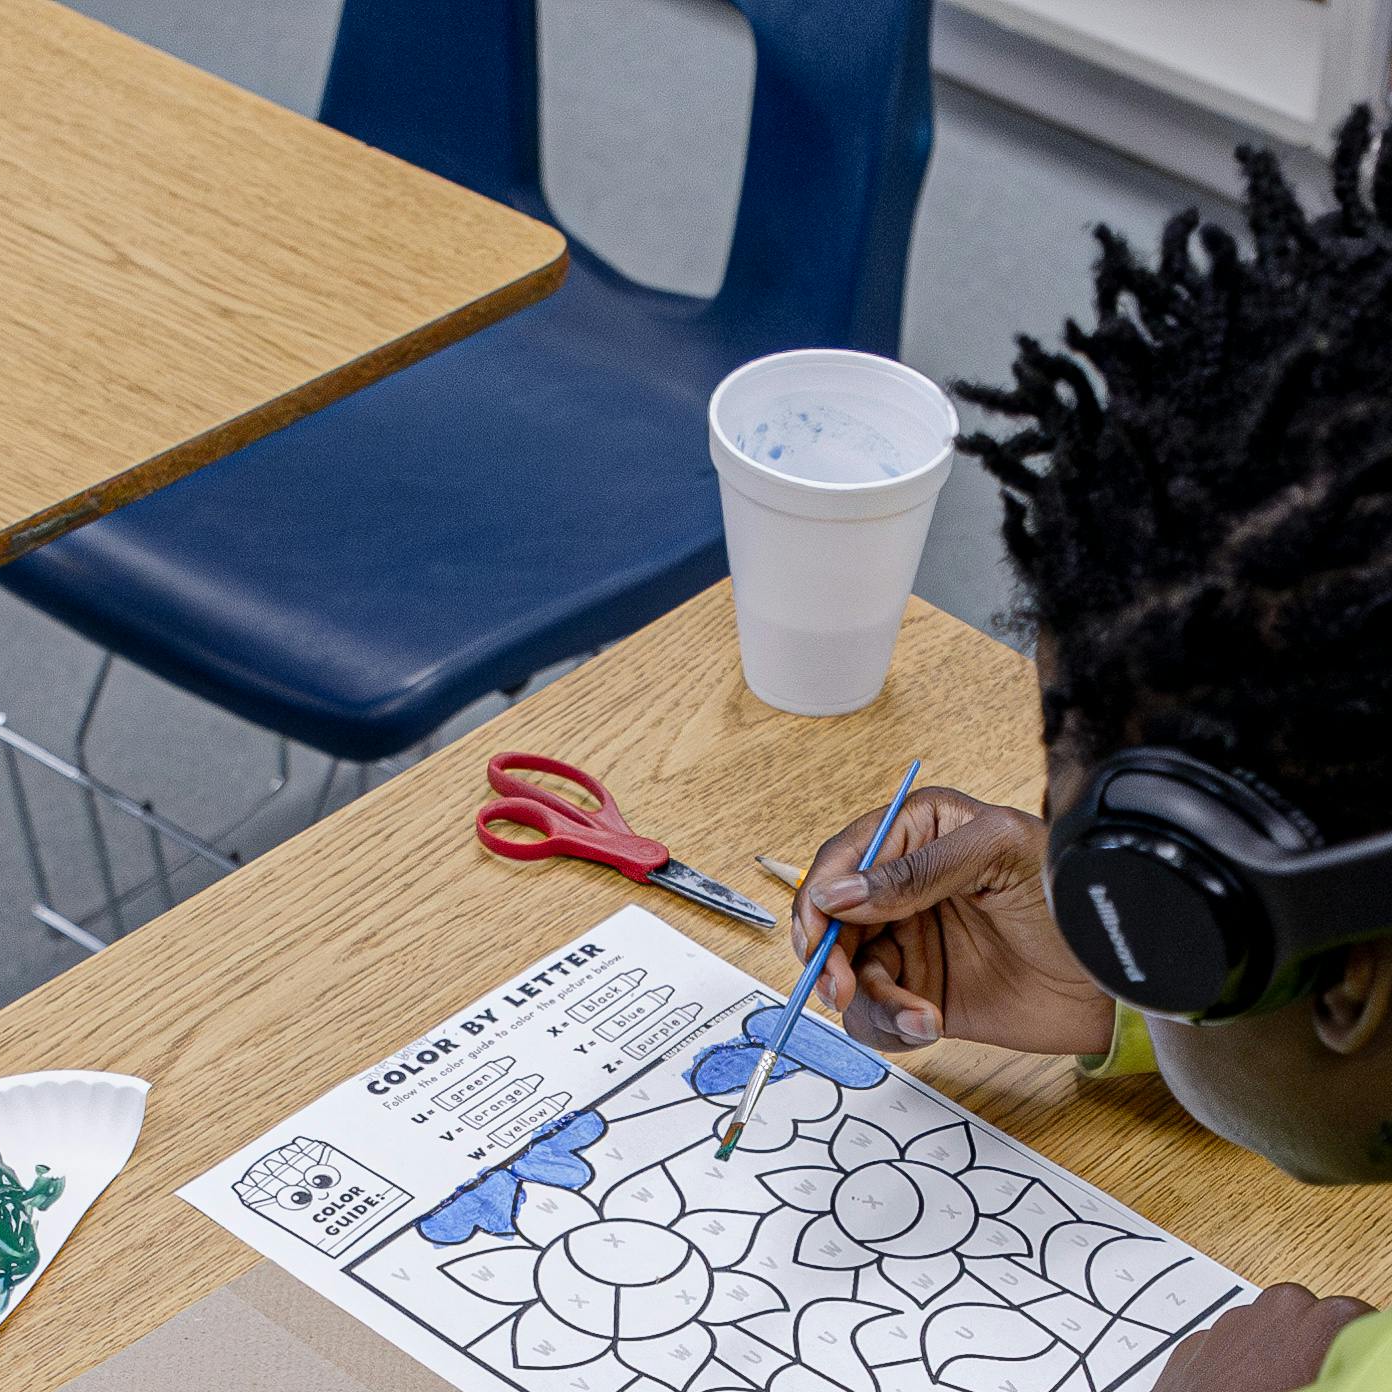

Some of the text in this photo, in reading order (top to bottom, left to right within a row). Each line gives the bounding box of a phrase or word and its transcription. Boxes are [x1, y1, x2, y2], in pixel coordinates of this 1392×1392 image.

[582, 984, 624, 1013] black
[366, 942, 608, 1096] COLOR BY LETTER
[612, 1004, 646, 1028] blue
[382, 953, 626, 1112] Follow the color guide to color the picture below.
[636, 1016, 681, 1053] purple
[449, 1072, 493, 1103] green
[631, 1089, 650, 1101] V
[473, 1088, 524, 1123] orange
[889, 1101, 908, 1113] V
[503, 1107, 549, 1140] yellow
[850, 1133, 872, 1149] W
[605, 1148, 624, 1160] V
[928, 1146, 950, 1161] W
[705, 1166, 724, 1179] V
[794, 1179, 817, 1195] W
[996, 1181, 1017, 1196] W
[631, 1187, 654, 1203] W
[862, 1195, 883, 1209] X
[311, 1185, 366, 1225] COLOR
[536, 1198, 559, 1214] W
[940, 1205, 962, 1219] X
[1027, 1203, 1045, 1215] V
[1080, 1199, 1098, 1213] V
[324, 1193, 387, 1237] GUIDE:
[702, 1220, 725, 1235] W
[603, 1233, 625, 1248] X
[986, 1231, 1008, 1246] W
[1070, 1235, 1089, 1247] U
[819, 1240, 842, 1257] W
[760, 1256, 778, 1269] V
[391, 1268, 410, 1280] V
[472, 1266, 495, 1281] W
[912, 1273, 934, 1289] W
[1000, 1272, 1018, 1285] U
[1116, 1269, 1134, 1282] V
[675, 1289, 697, 1305] X
[726, 1285, 749, 1301] W
[1166, 1293, 1186, 1306] Z
[568, 1294, 589, 1309] X
[1061, 1318, 1081, 1331] U
[817, 1331, 837, 1344] U
[889, 1326, 908, 1339] V
[955, 1326, 974, 1339] U
[532, 1339, 556, 1356] W
[1117, 1336, 1138, 1350] Z
[668, 1344, 692, 1360] W
[742, 1350, 762, 1364] U
[570, 1377, 590, 1390] V
[998, 1380, 1018, 1392] V
